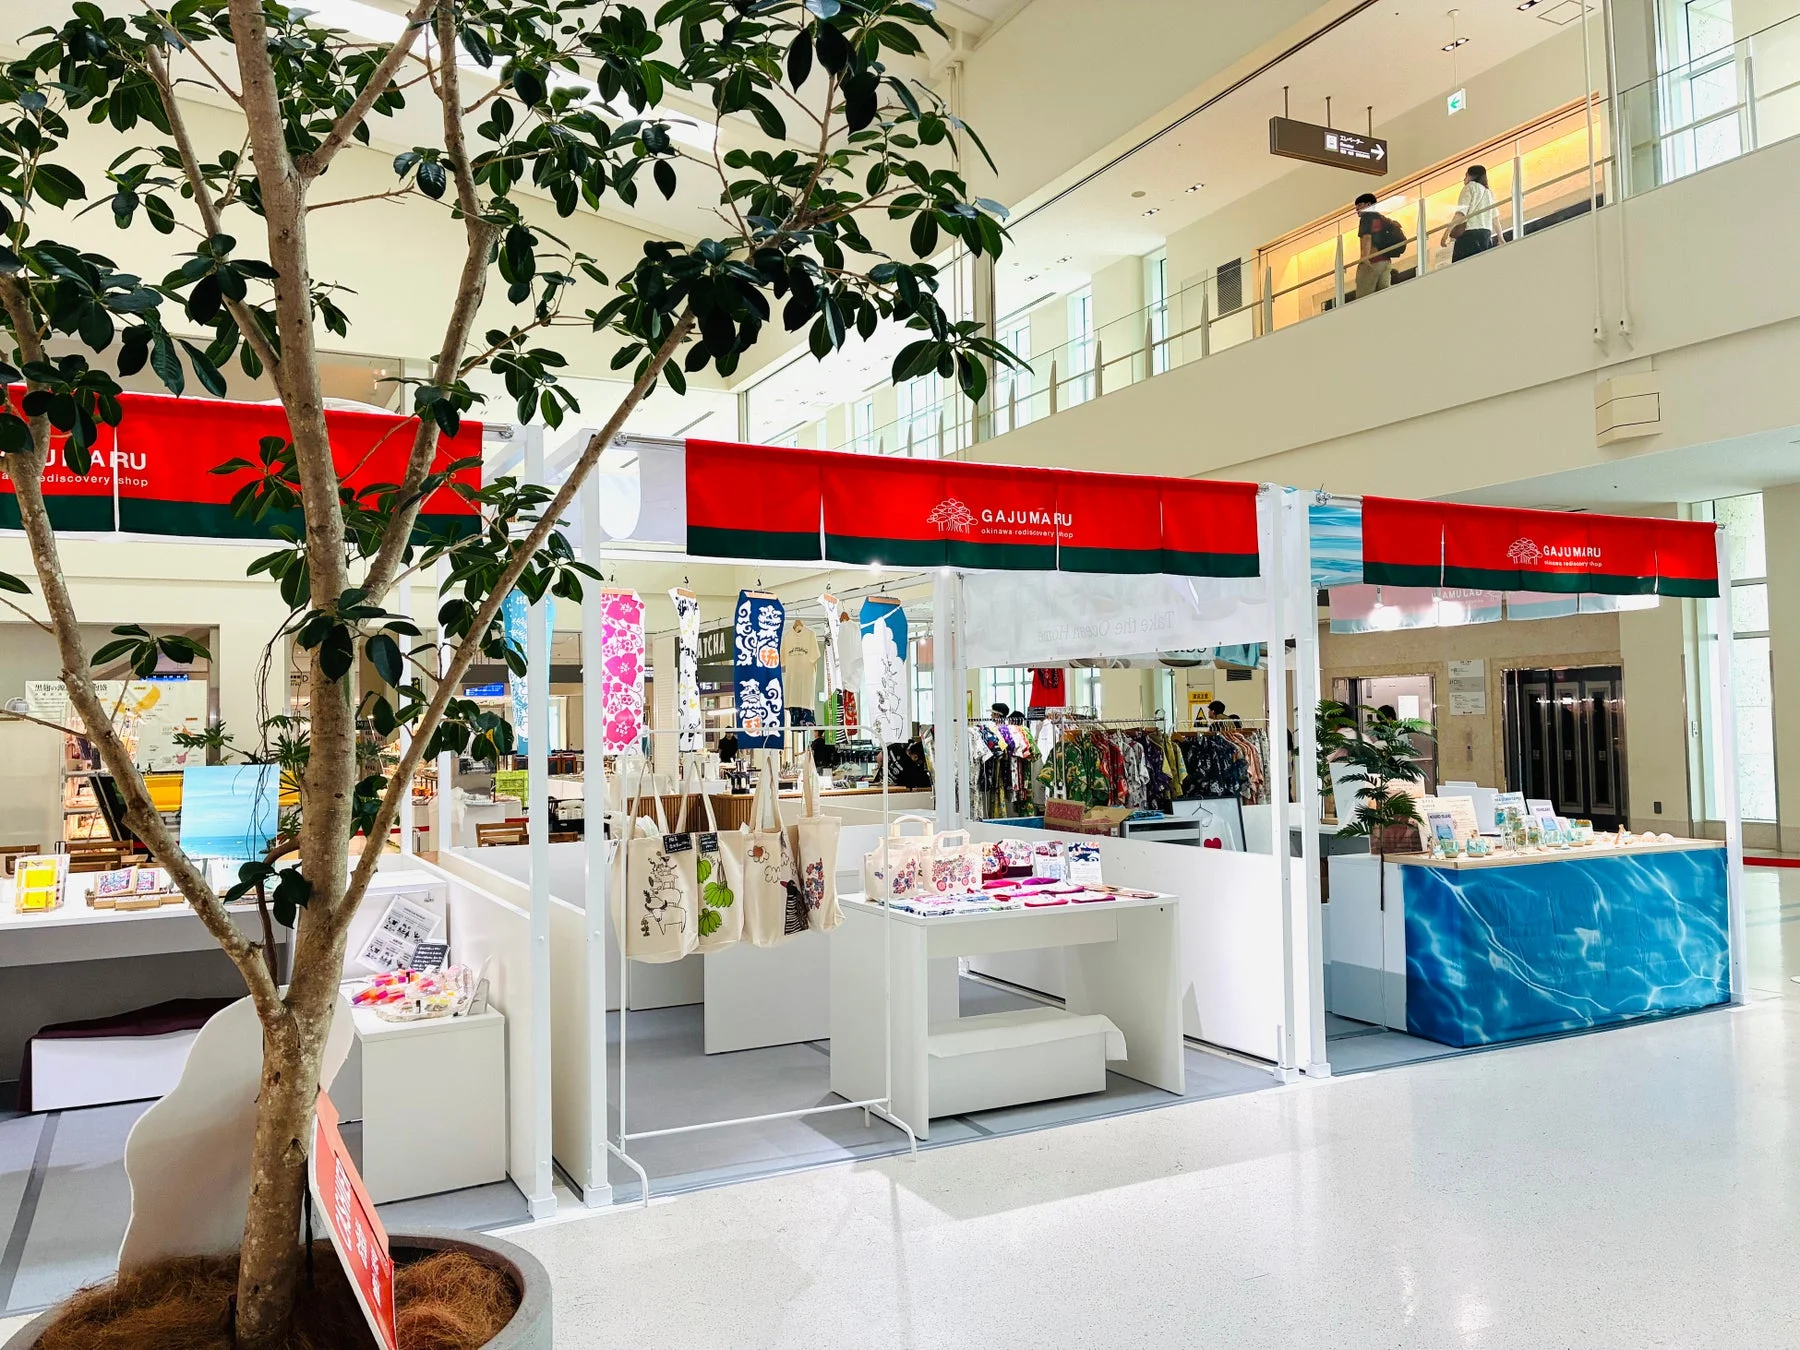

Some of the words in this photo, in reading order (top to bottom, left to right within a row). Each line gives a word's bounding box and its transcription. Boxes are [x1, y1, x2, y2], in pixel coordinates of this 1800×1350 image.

[40, 474, 110, 485] ediscovery
[981, 509, 1073, 527] GAJUMARU
[1015, 528, 1054, 538] rediscovery
[697, 632, 725, 659] ATCHA
